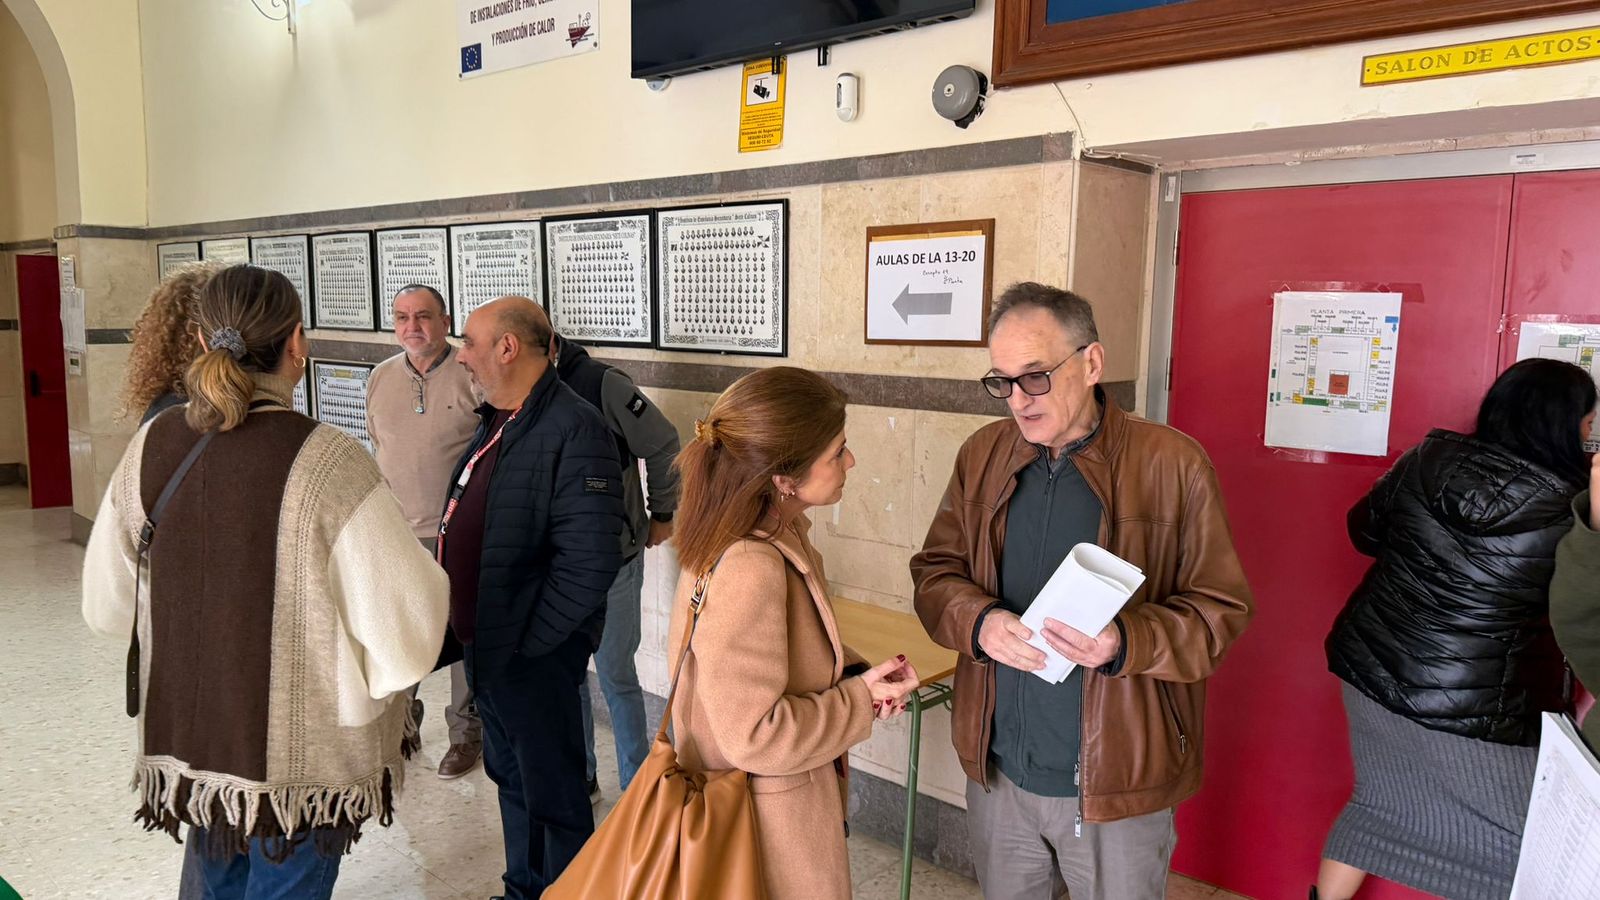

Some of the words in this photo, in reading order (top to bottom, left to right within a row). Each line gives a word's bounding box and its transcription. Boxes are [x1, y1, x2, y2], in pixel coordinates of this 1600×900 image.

[470, 10, 477, 24] DE
[477, 0, 514, 22] INSTALACIONES
[514, 0, 522, 12] DE
[491, 32, 495, 46] Y
[495, 21, 528, 45] PRODUCCIÓN
[528, 22, 536, 37] DE
[536, 17, 555, 36] CALOR
[1375, 52, 1452, 76] SALON
[1463, 47, 1493, 65] DE
[1504, 35, 1592, 60] ACTOS
[876, 253, 909, 266] AULAS
[912, 253, 926, 264] DE
[928, 252, 941, 263] LA
[945, 250, 976, 263] 13-20
